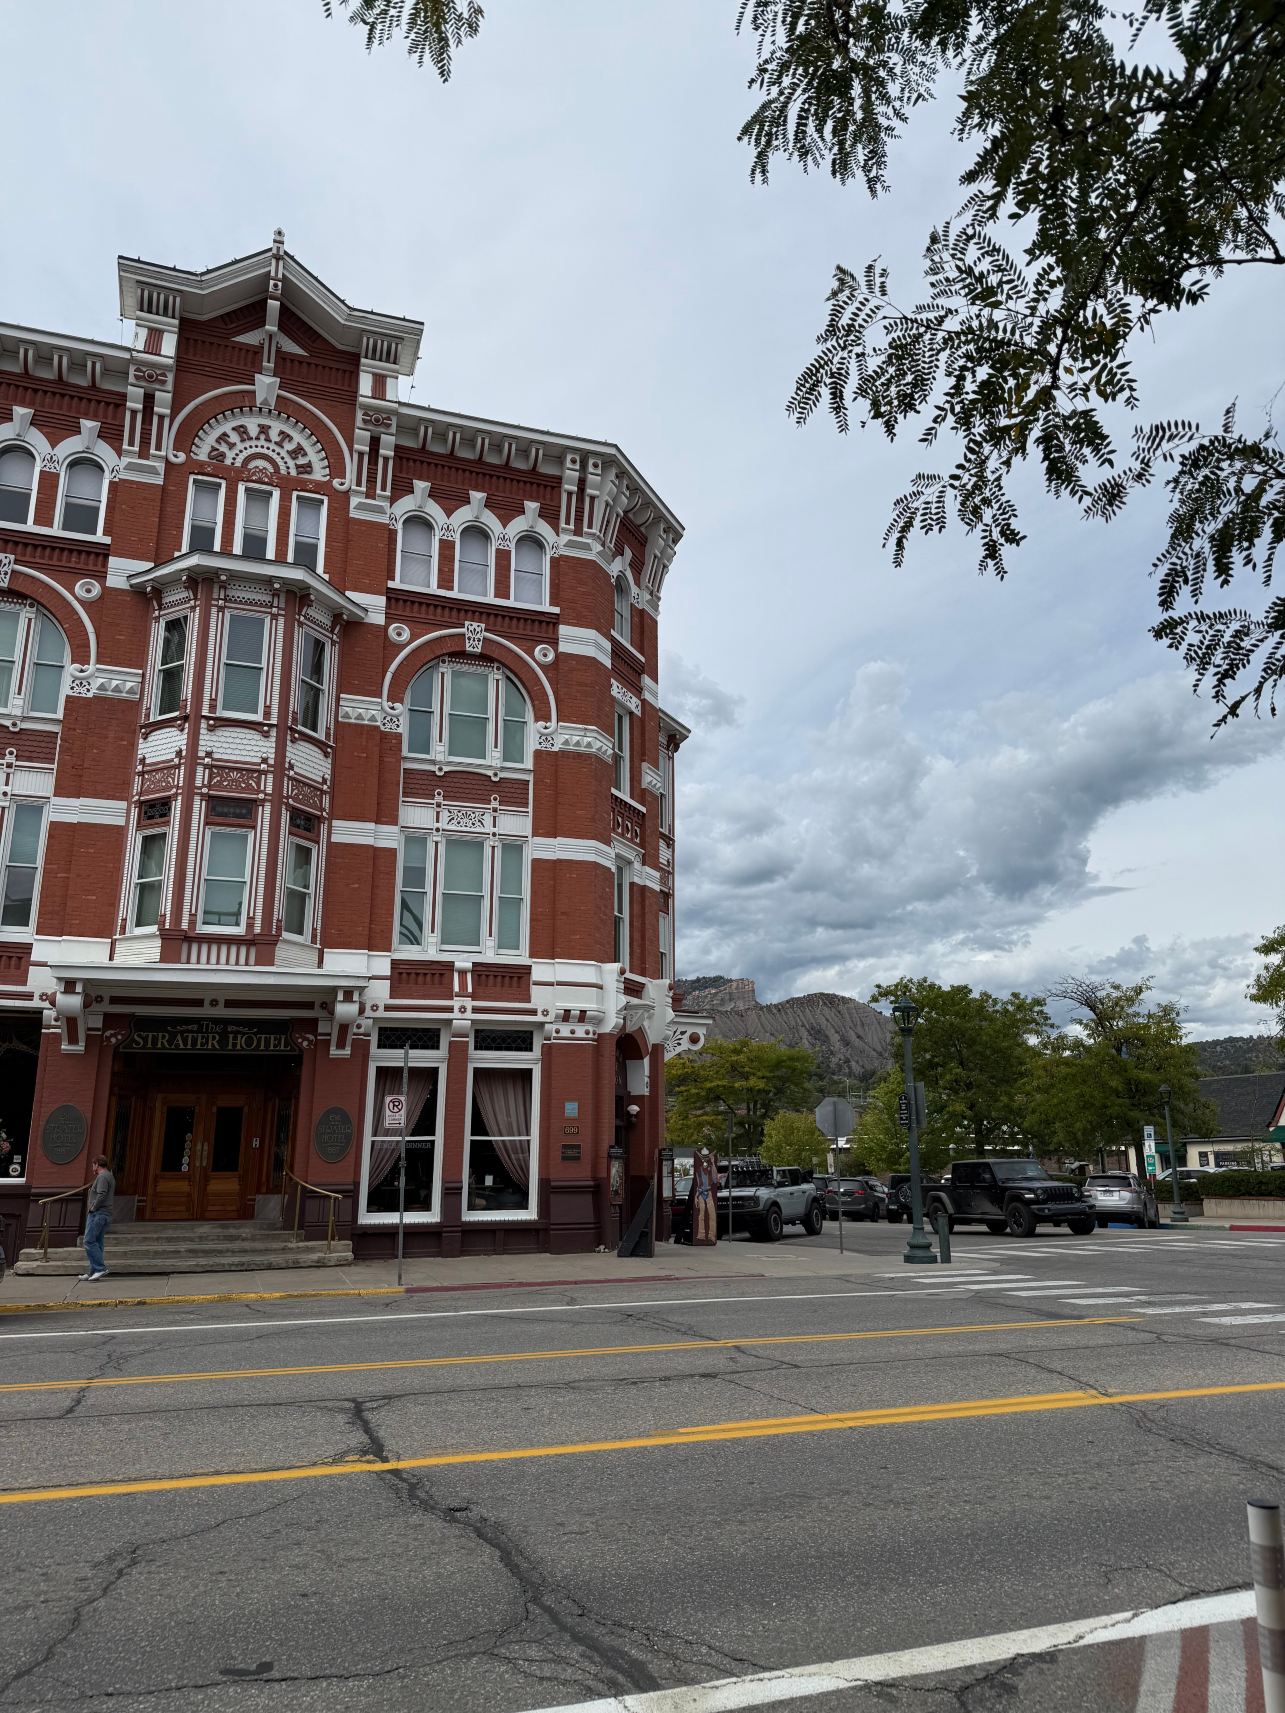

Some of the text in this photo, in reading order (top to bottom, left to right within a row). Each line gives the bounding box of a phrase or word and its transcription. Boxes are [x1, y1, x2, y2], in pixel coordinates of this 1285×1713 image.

[208, 423, 313, 475] STRATER
[201, 1021, 223, 1033] The
[132, 1032, 291, 1050] STRATER HOTEL
[564, 1126, 578, 1134] 699
